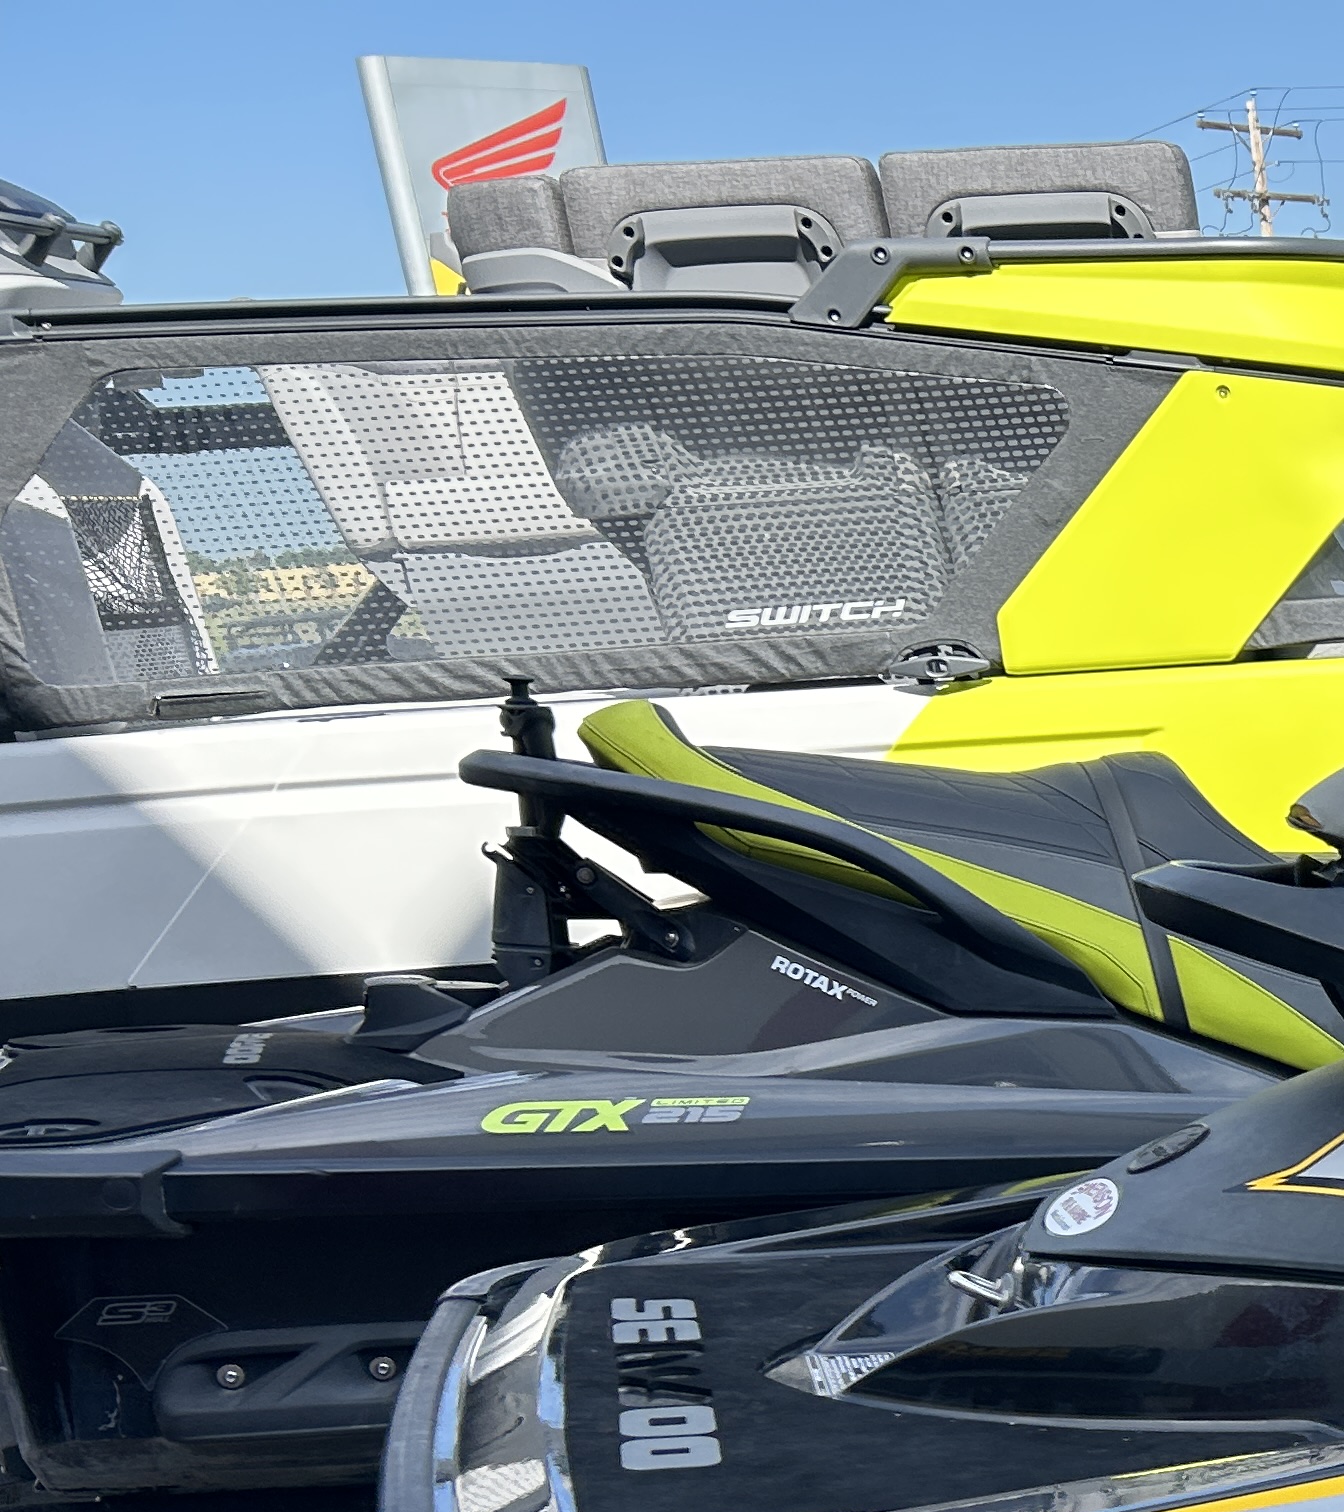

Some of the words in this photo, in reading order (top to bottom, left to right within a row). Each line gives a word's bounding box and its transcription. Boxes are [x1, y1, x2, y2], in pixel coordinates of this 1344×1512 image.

[724, 598, 907, 630] SWITCH
[770, 955, 848, 1001] ROTAX
[846, 988, 879, 1008] POWER
[480, 1098, 647, 1134] GTX
[641, 1106, 746, 1125] 215
[96, 1300, 177, 1326] S3
